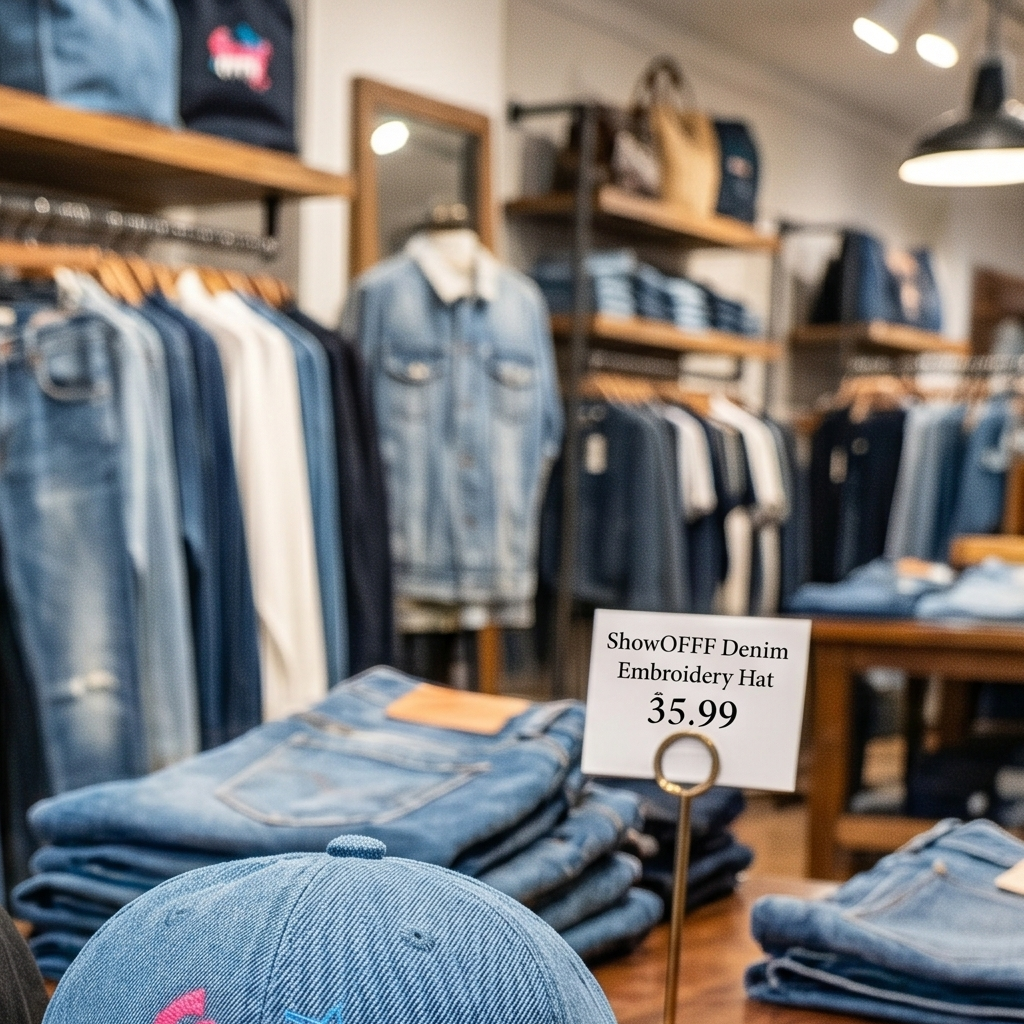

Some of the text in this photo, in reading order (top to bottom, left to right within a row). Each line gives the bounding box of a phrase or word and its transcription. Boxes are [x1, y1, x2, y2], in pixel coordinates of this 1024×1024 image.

[606, 631, 789, 660] ShowOFFF Denim
[617, 661, 775, 691] Embroidery Hat
